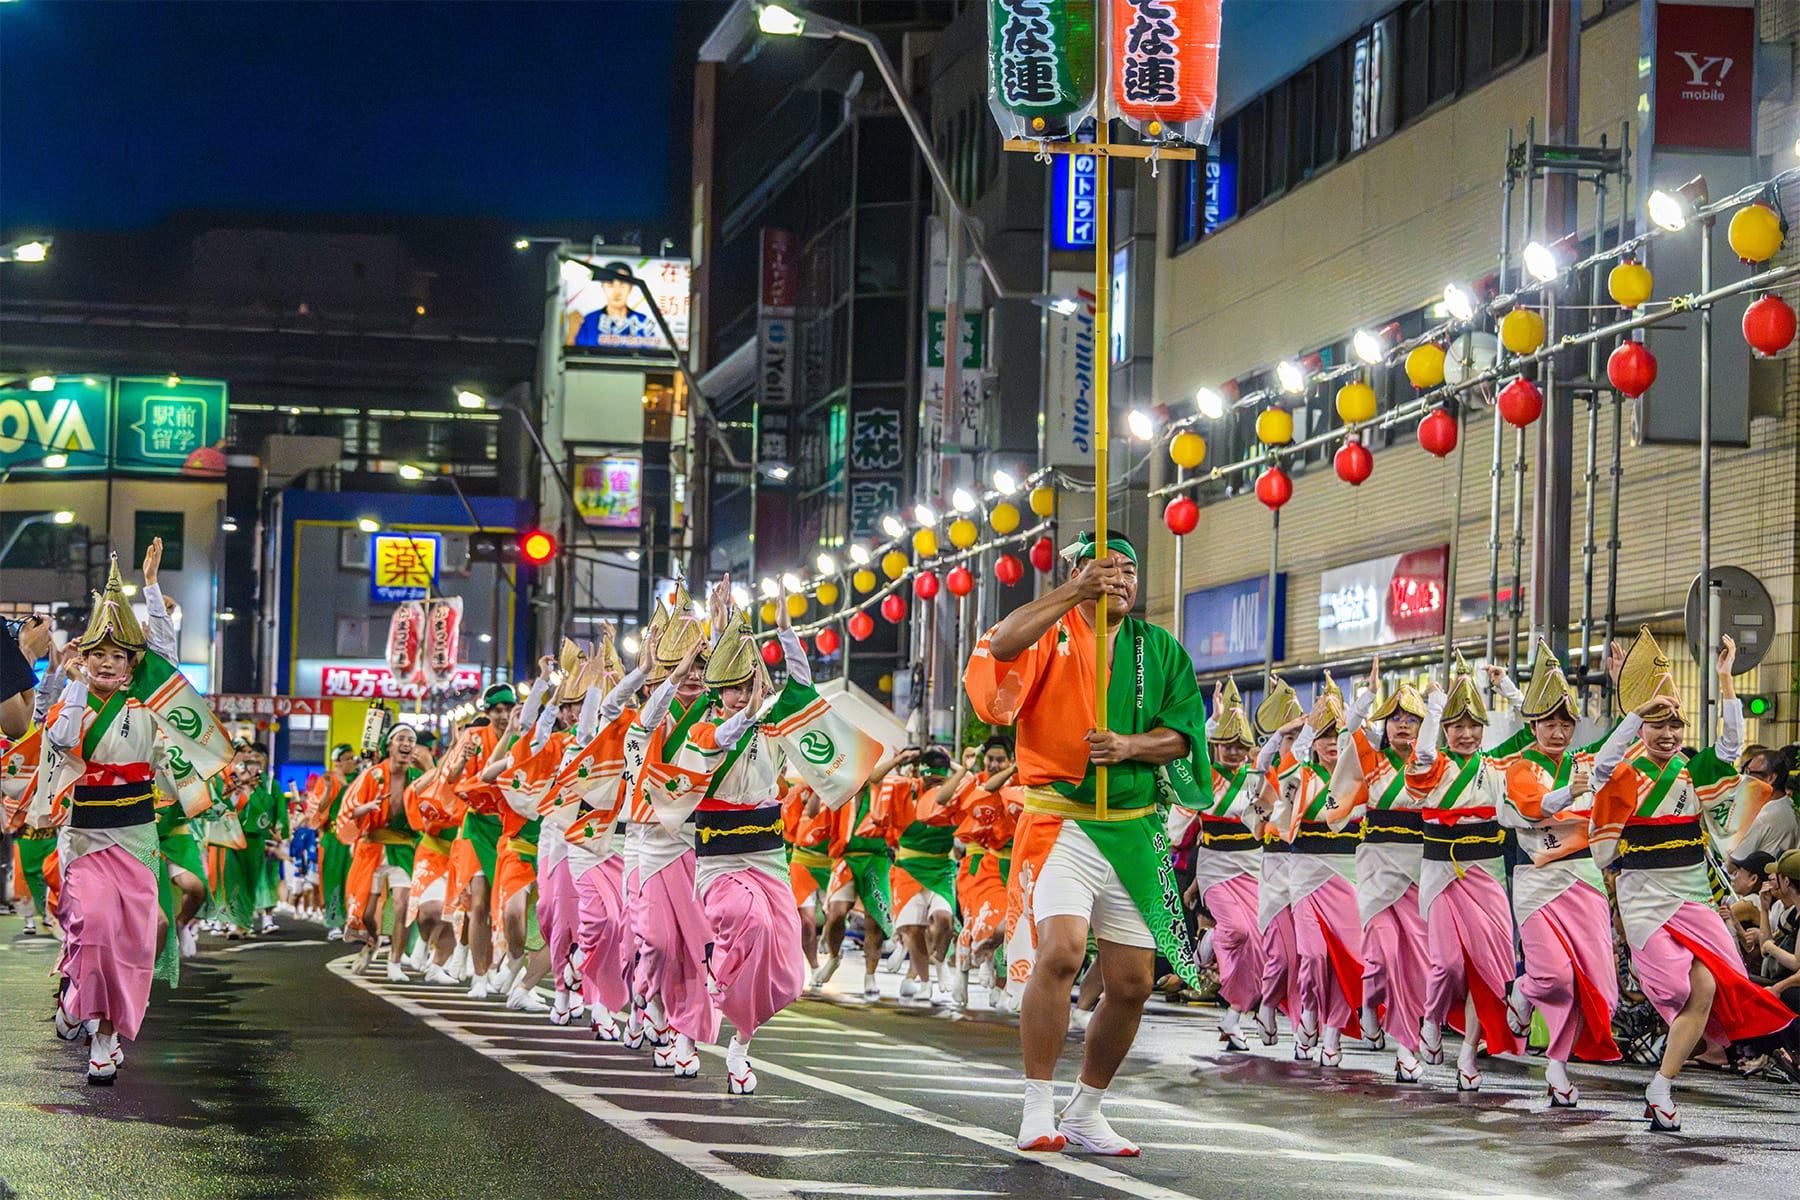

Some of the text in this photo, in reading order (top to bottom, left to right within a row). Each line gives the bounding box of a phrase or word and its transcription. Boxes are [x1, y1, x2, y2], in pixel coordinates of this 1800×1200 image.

[1674, 51, 1734, 87] Y!
[1681, 89, 1725, 101] mobile
[152, 405, 196, 427] 駅前
[151, 428, 196, 450] 留学
[384, 542, 427, 585] 薬
[1228, 591, 1260, 654] AOKI
[325, 668, 478, 698] 処方せん付
